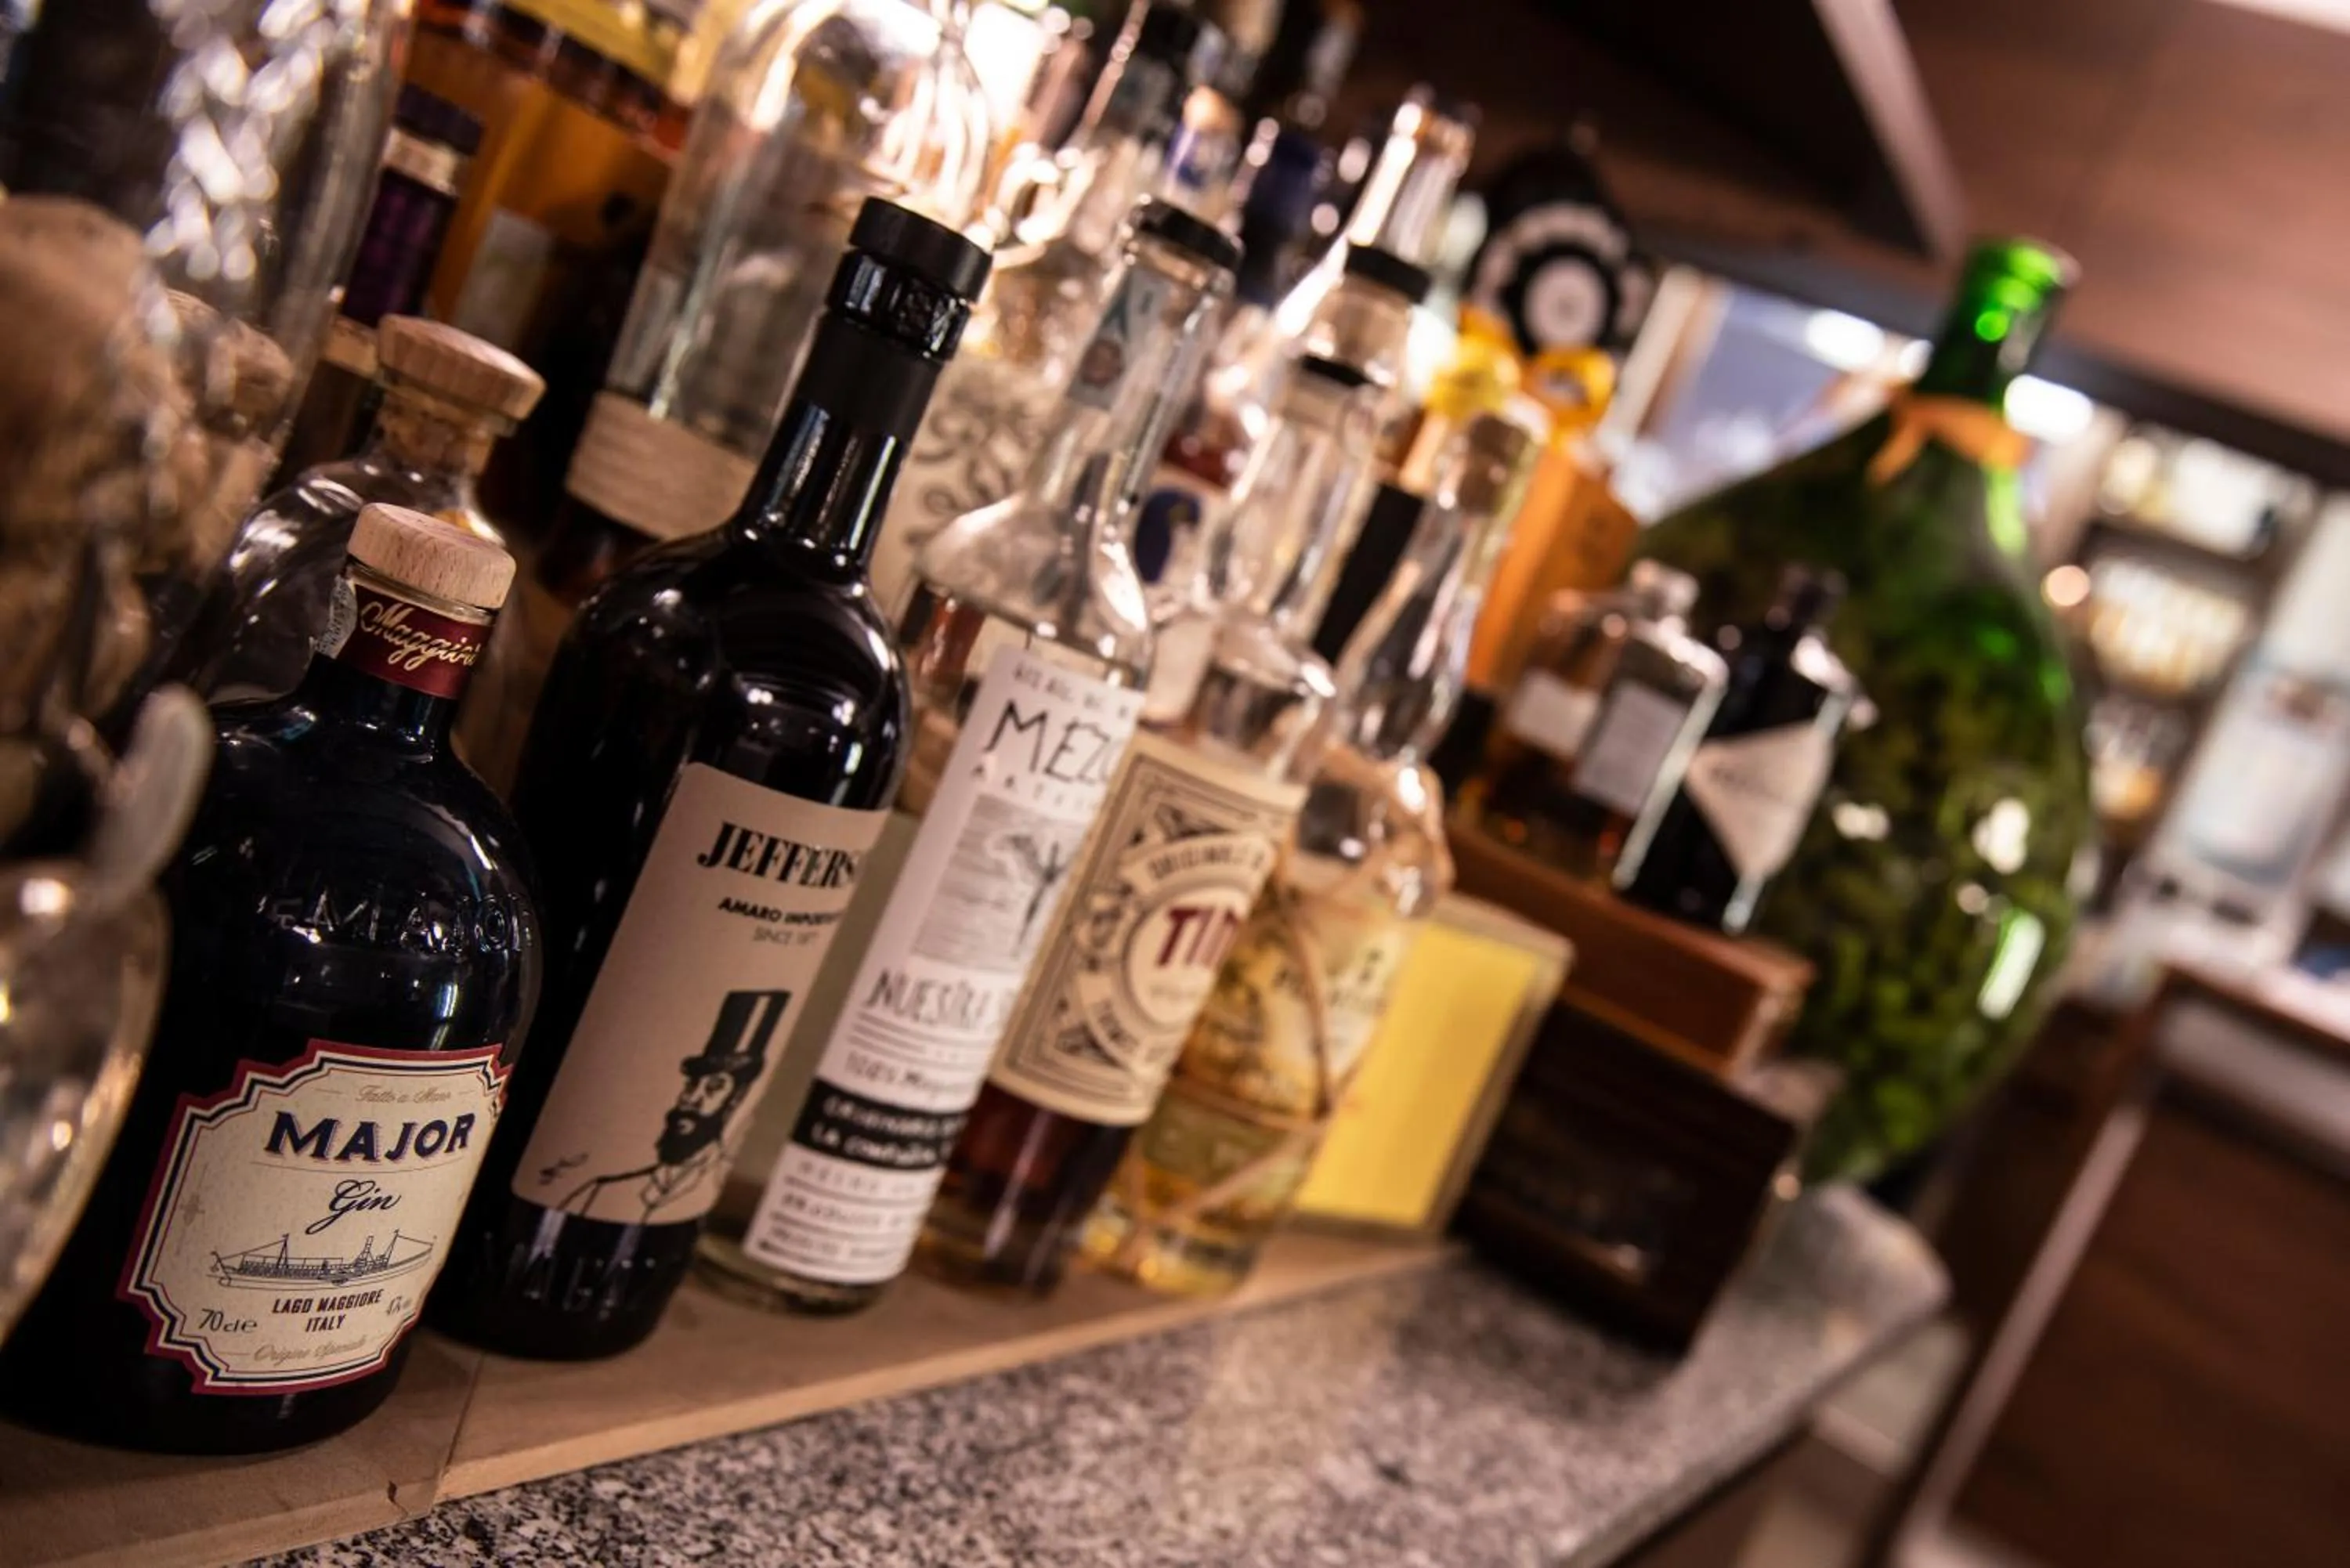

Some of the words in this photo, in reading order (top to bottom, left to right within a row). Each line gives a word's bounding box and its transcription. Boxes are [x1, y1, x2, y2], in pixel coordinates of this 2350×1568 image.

[718, 897, 783, 923] AMARO
[264, 1111, 475, 1164] MAJOR
[305, 1180, 402, 1235] Gin
[272, 1299, 313, 1313] LAGO
[316, 1288, 384, 1313] MAGGIORE
[305, 1314, 347, 1332] ITALY
